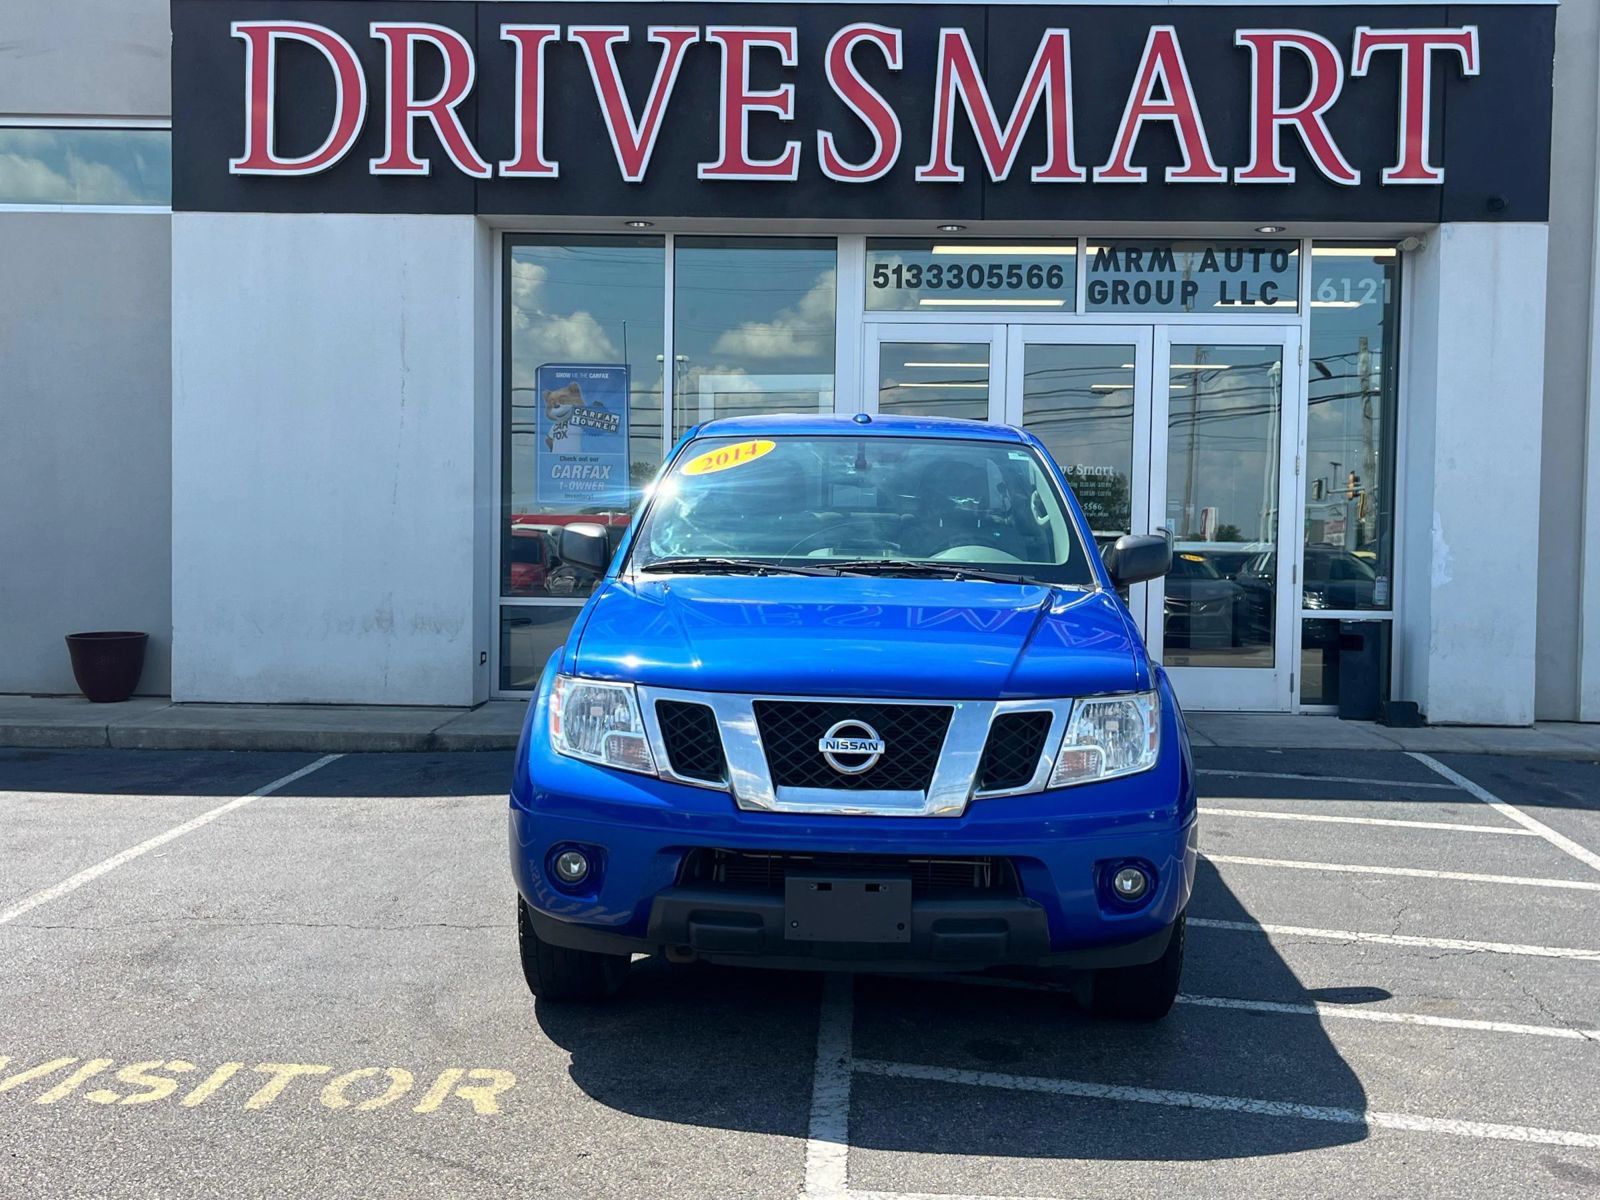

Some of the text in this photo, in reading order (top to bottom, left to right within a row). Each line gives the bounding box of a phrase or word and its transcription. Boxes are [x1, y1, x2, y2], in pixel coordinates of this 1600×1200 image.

[228, 20, 1480, 187] DRIVESMART
[1092, 247, 1289, 273] MRM AUTO
[873, 263, 1064, 289] 5133305566
[1087, 279, 1280, 305] GROUP LLC
[1316, 277, 1391, 304] 6121
[574, 408, 619, 424] CARFAX
[701, 442, 758, 472] 2014
[1076, 464, 1114, 476] Smart
[551, 464, 611, 479] CARFAX
[560, 481, 605, 491] 1-OWNER
[825, 741, 878, 751] NISSAN
